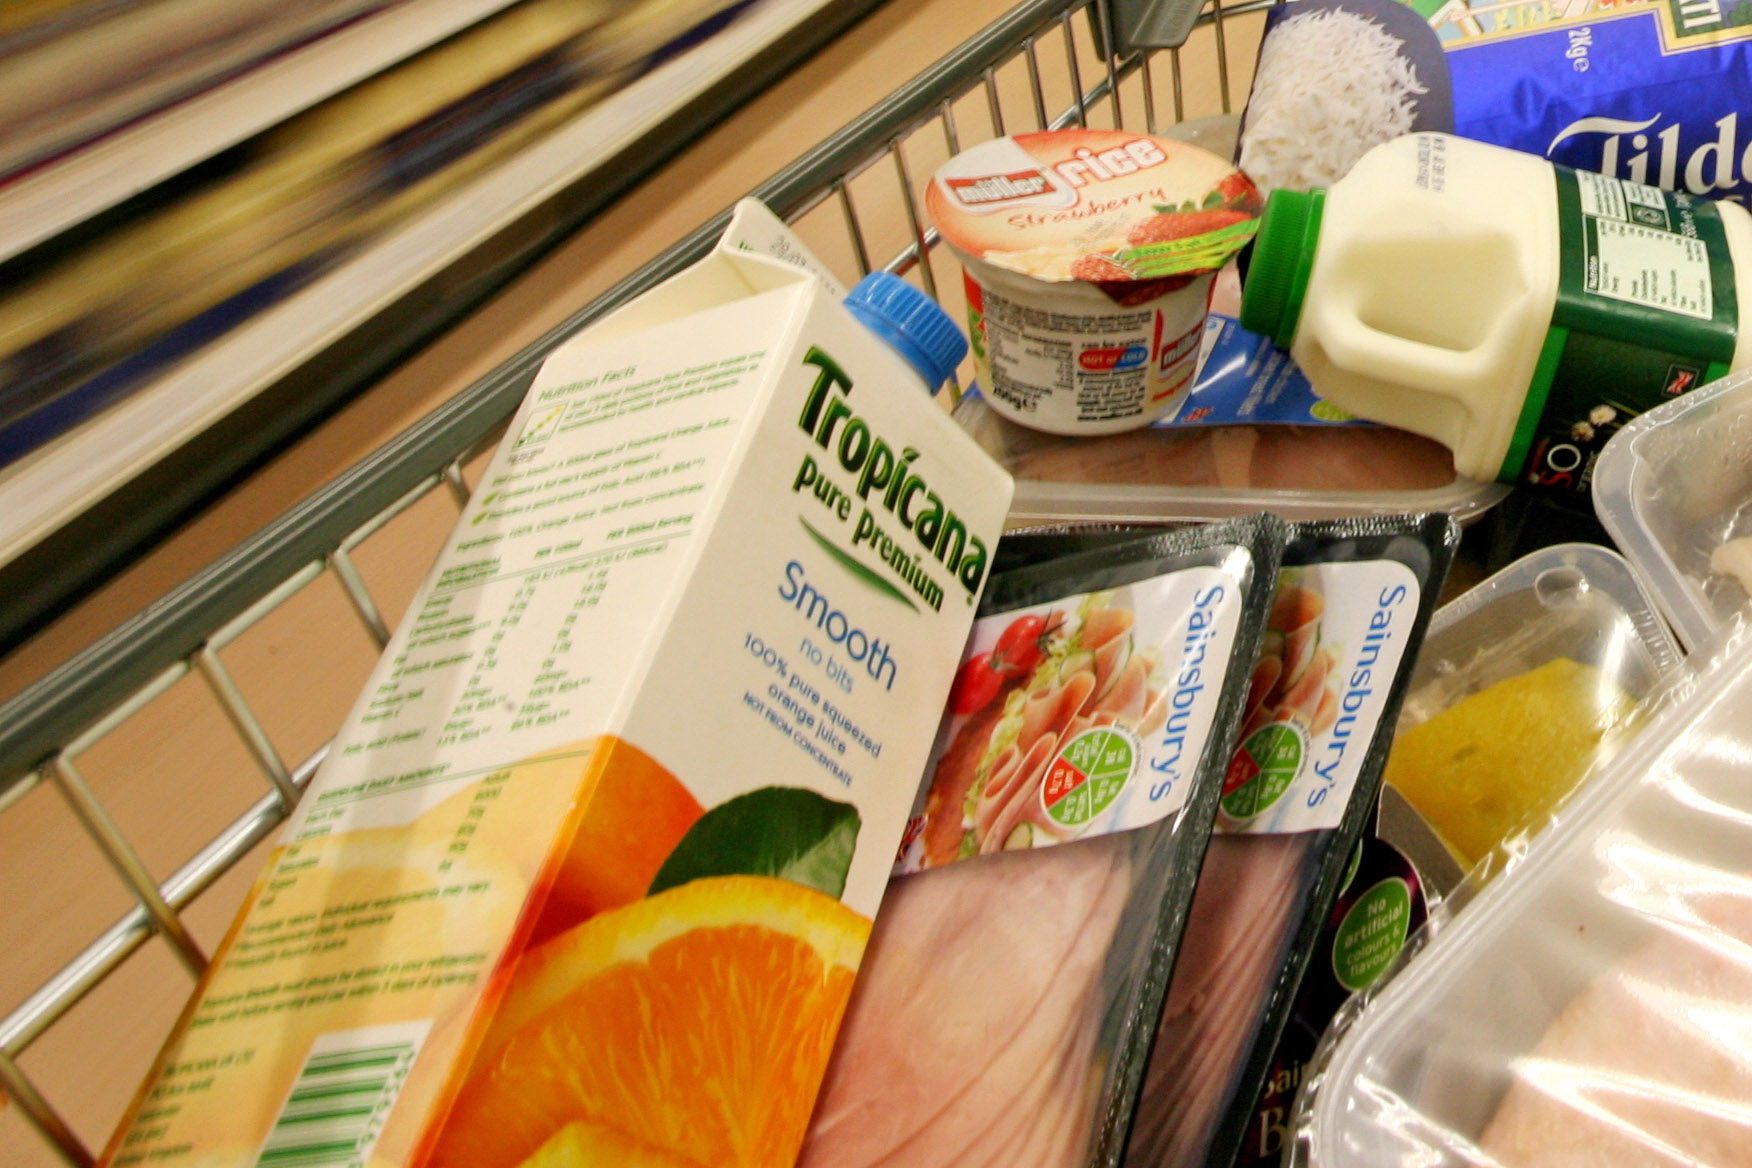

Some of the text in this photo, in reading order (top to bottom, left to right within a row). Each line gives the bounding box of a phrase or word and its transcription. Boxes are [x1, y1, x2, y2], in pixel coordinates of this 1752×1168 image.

[1055, 139, 1167, 189] rice
[1008, 187, 1168, 230] Strawberry
[798, 344, 987, 596] Tropicana
[792, 454, 945, 613] pure premium
[778, 560, 897, 692] Smooth
[744, 632, 883, 759] 100% pure squeezed
[800, 637, 854, 694] no bits
[1149, 583, 1225, 802] Sainsbury's
[1307, 583, 1406, 808] Sainsbury's
[743, 692, 853, 789] NOT FROM CONCENTRATE
[768, 683, 847, 755] orange juice
[1344, 904, 1403, 949] artificial
[1367, 898, 1387, 918] No
[1346, 933, 1390, 963] colours
[1349, 944, 1397, 976] flavours
